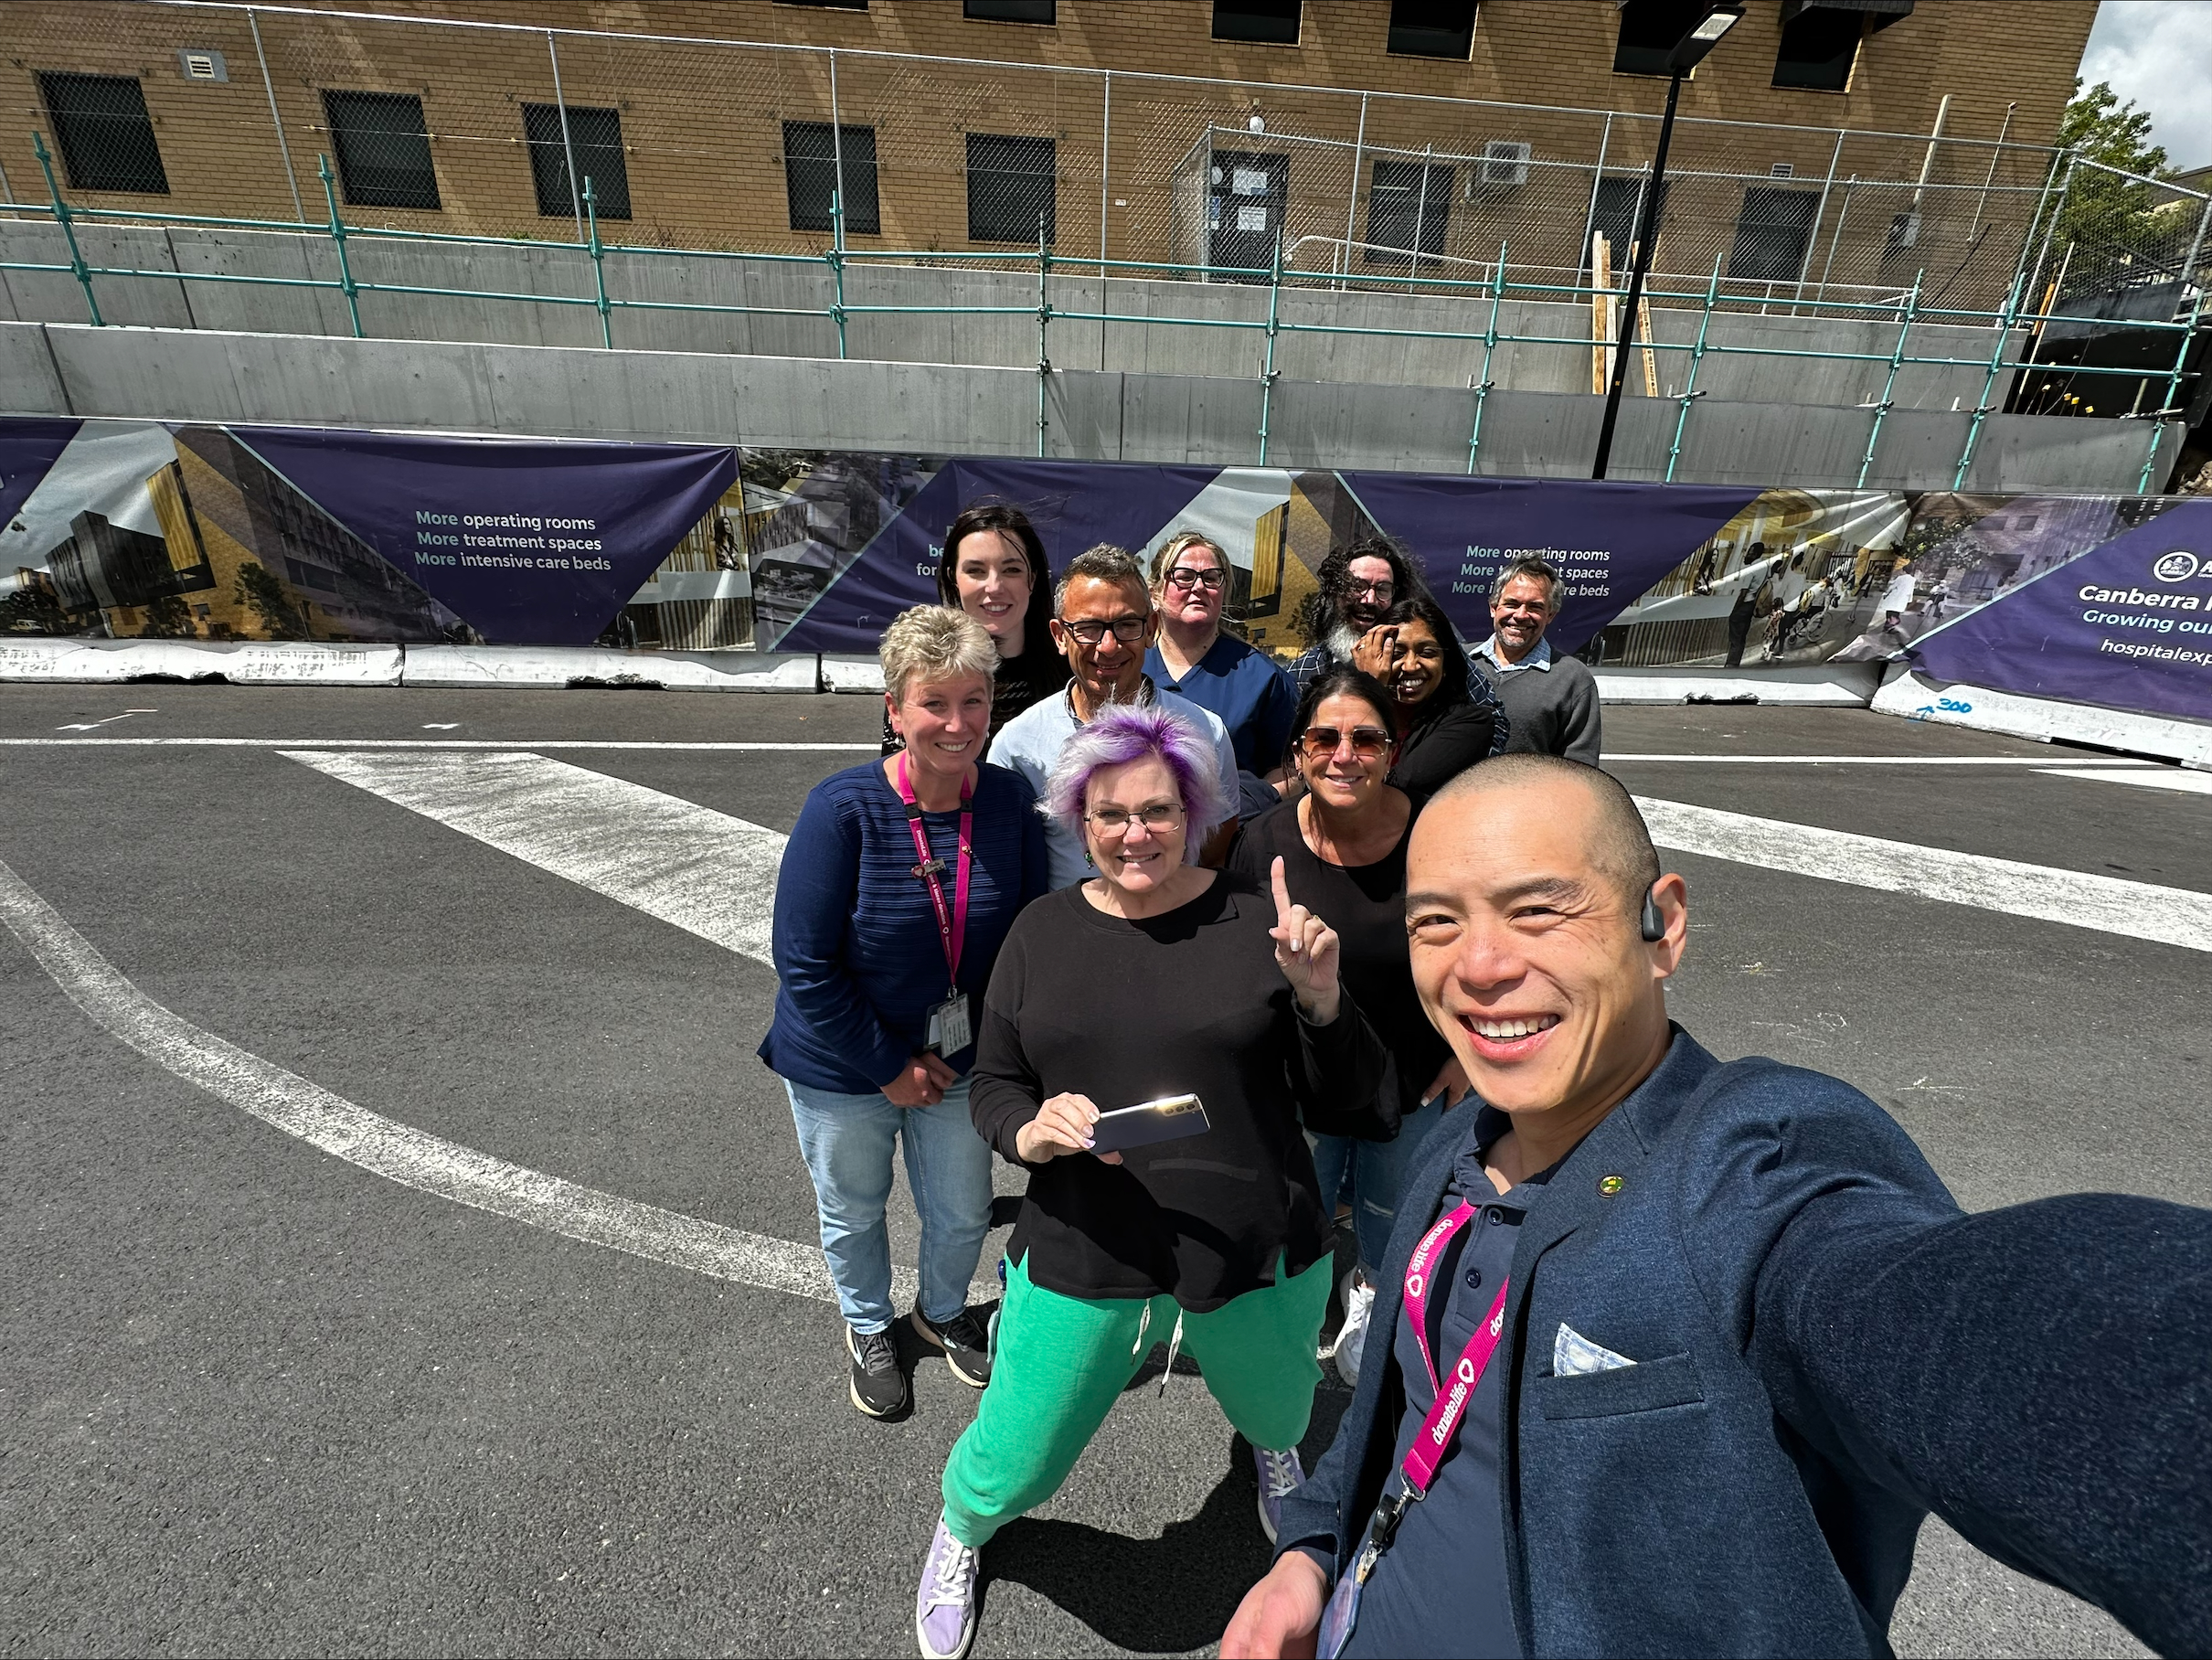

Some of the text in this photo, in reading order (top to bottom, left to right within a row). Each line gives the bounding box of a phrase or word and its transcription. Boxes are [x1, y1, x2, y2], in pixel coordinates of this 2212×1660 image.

[416, 511, 596, 531] More operating rooms
[417, 531, 602, 552] More treatment spaces
[414, 552, 611, 570] More intensive care beds
[1466, 545, 1500, 559] More
[1569, 549, 1611, 561] rooms
[916, 562, 938, 576] for
[1461, 563, 1494, 576] More
[1566, 567, 1610, 580] spaces
[1452, 581, 1485, 594] More
[1563, 586, 1578, 596] re
[1579, 584, 1611, 596] beds
[2079, 585, 2200, 611] Canberra
[2083, 610, 2175, 633] Growing
[1936, 697, 1973, 713] 300
[1431, 1381, 1468, 1445] donatelife
